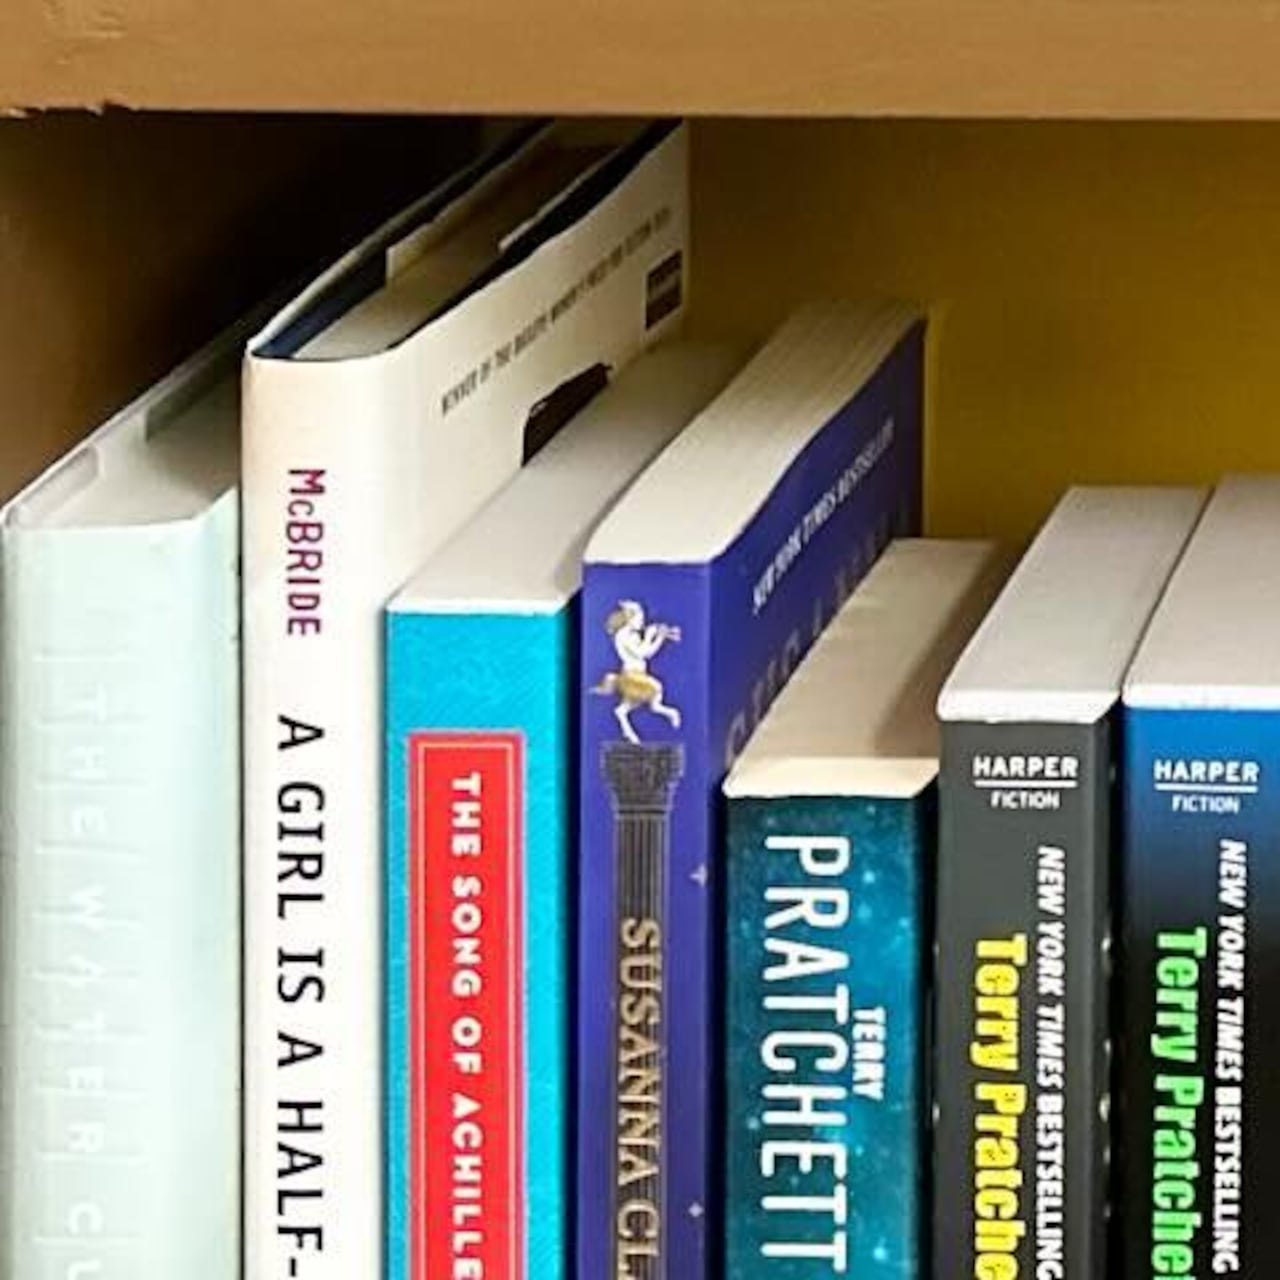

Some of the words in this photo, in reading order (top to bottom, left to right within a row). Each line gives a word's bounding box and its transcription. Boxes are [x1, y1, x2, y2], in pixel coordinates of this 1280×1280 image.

[285, 468, 327, 637] McBRIDE
[277, 714, 325, 751] A
[971, 755, 1079, 780] HARPER
[1153, 758, 1260, 784] HARPER
[451, 772, 482, 856] THE
[990, 790, 1061, 810] FICTION
[1171, 795, 1240, 815] FICTION
[277, 780, 325, 919] GIRL
[1034, 845, 1066, 917] NEW
[1217, 838, 1248, 910] NEW
[277, 948, 325, 1003] IS
[451, 876, 482, 998] SONG
[1034, 921, 1066, 997] YORK
[1215, 913, 1247, 990] YORK
[969, 933, 1028, 1072] Terry
[1150, 926, 1208, 1064] Terry
[277, 1031, 324, 1069] A
[451, 1019, 482, 1074] OF
[616, 917, 663, 1187] SUSANNA
[759, 835, 851, 1274] PRATCHETT
[853, 1006, 887, 1101] TERRY
[1034, 1000, 1066, 1091] TIMES
[1213, 994, 1245, 1082] TIMES
[277, 1100, 324, 1279] HALF-
[1211, 1085, 1244, 1275] BESTSELLING
